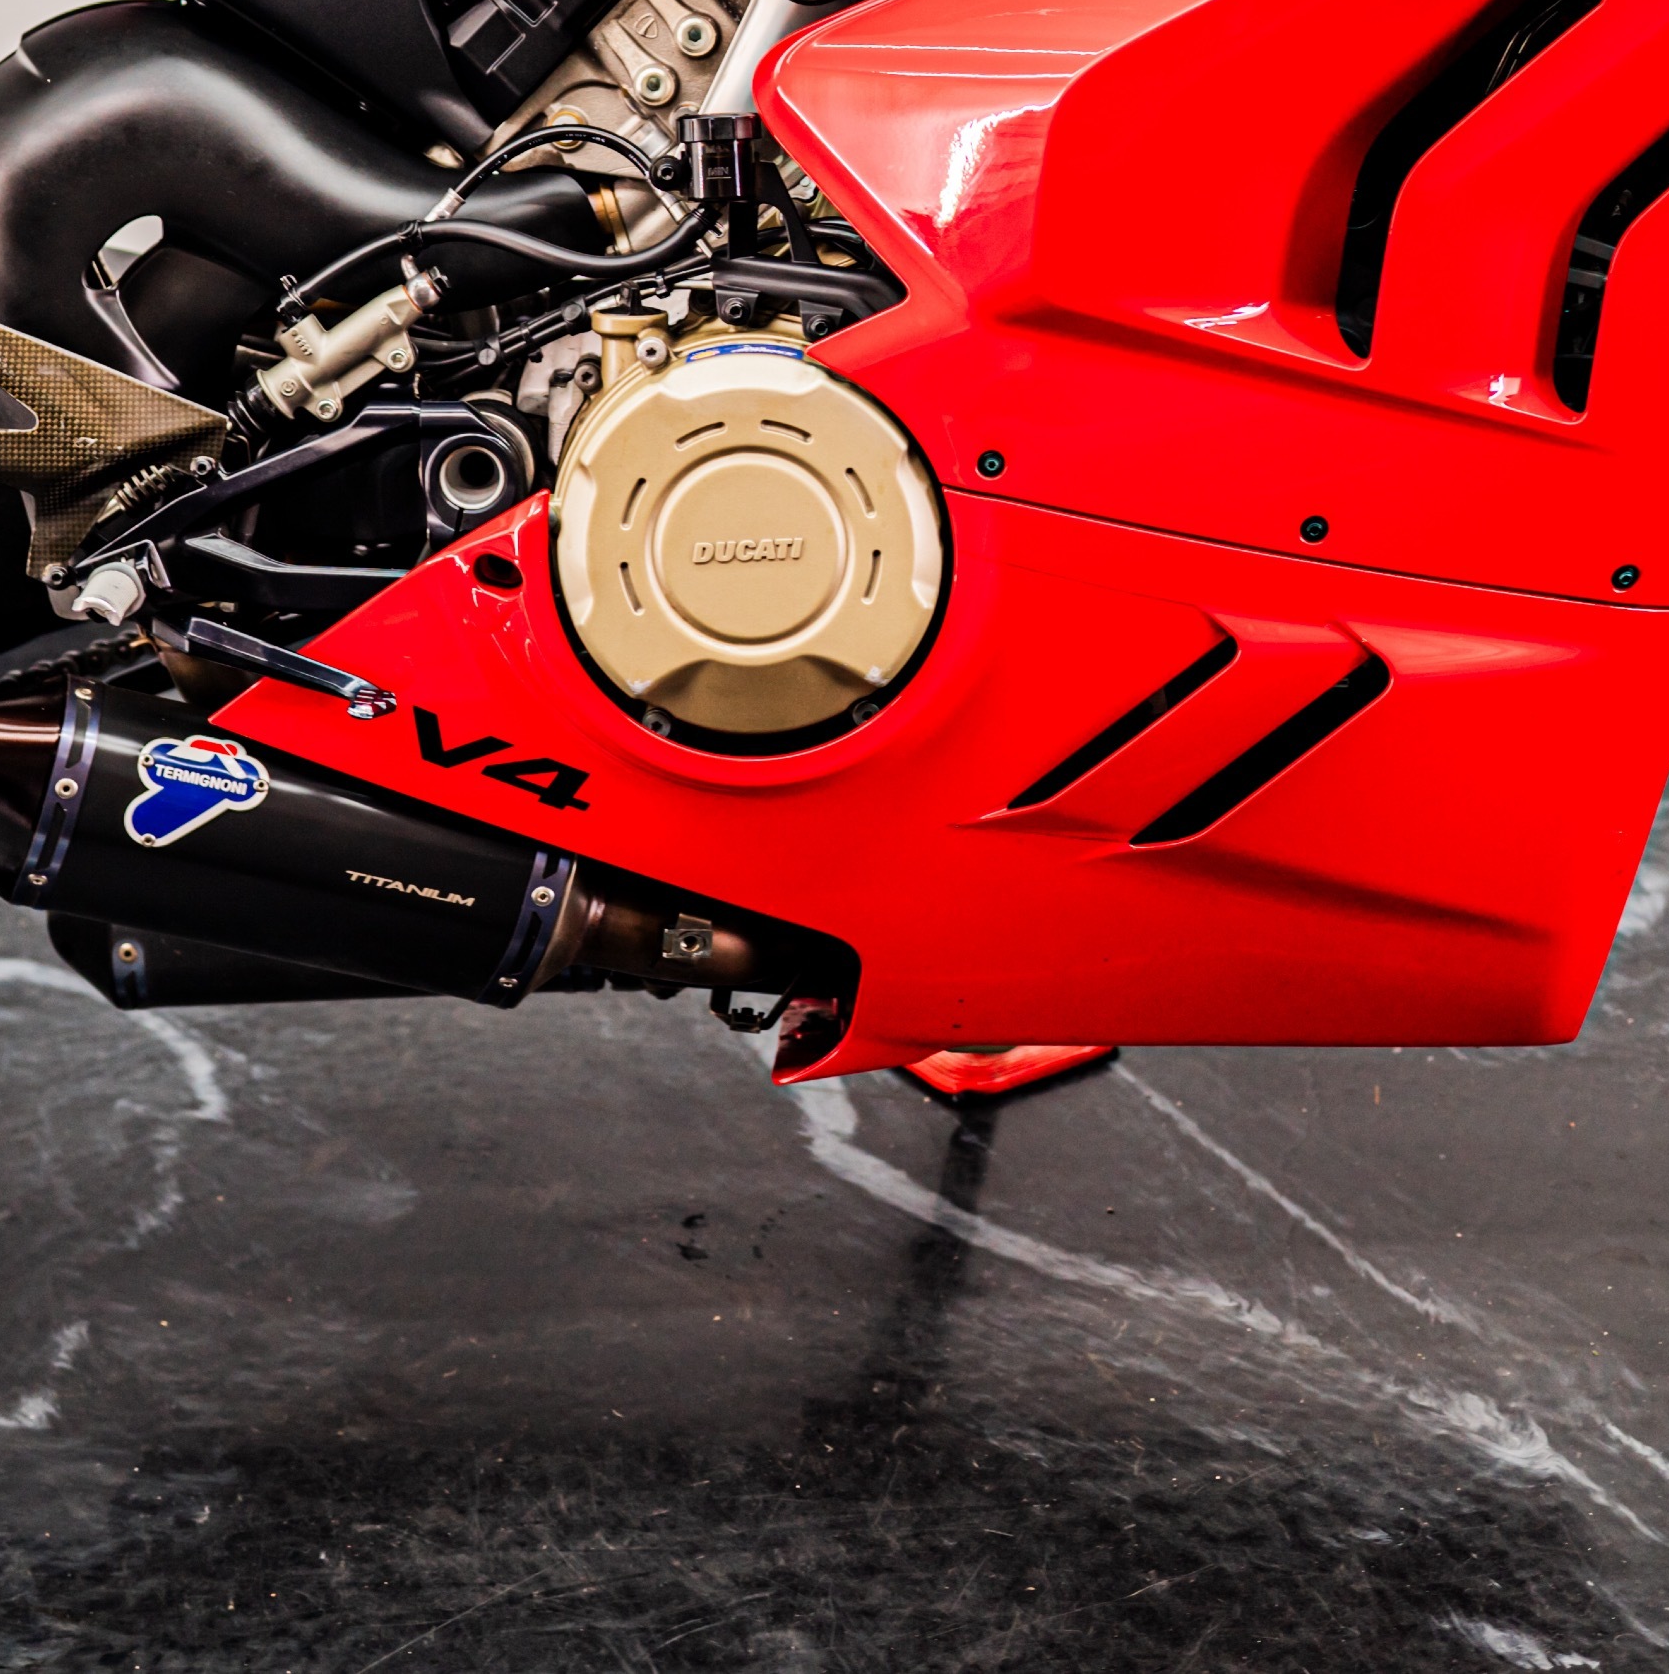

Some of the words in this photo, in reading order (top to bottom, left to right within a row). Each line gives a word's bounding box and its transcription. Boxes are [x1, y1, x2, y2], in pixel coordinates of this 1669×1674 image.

[692, 537, 803, 565] DUCATI
[412, 705, 591, 812] V4
[154, 763, 248, 796] TERMIGNONI
[346, 869, 476, 907] TITANIUM
